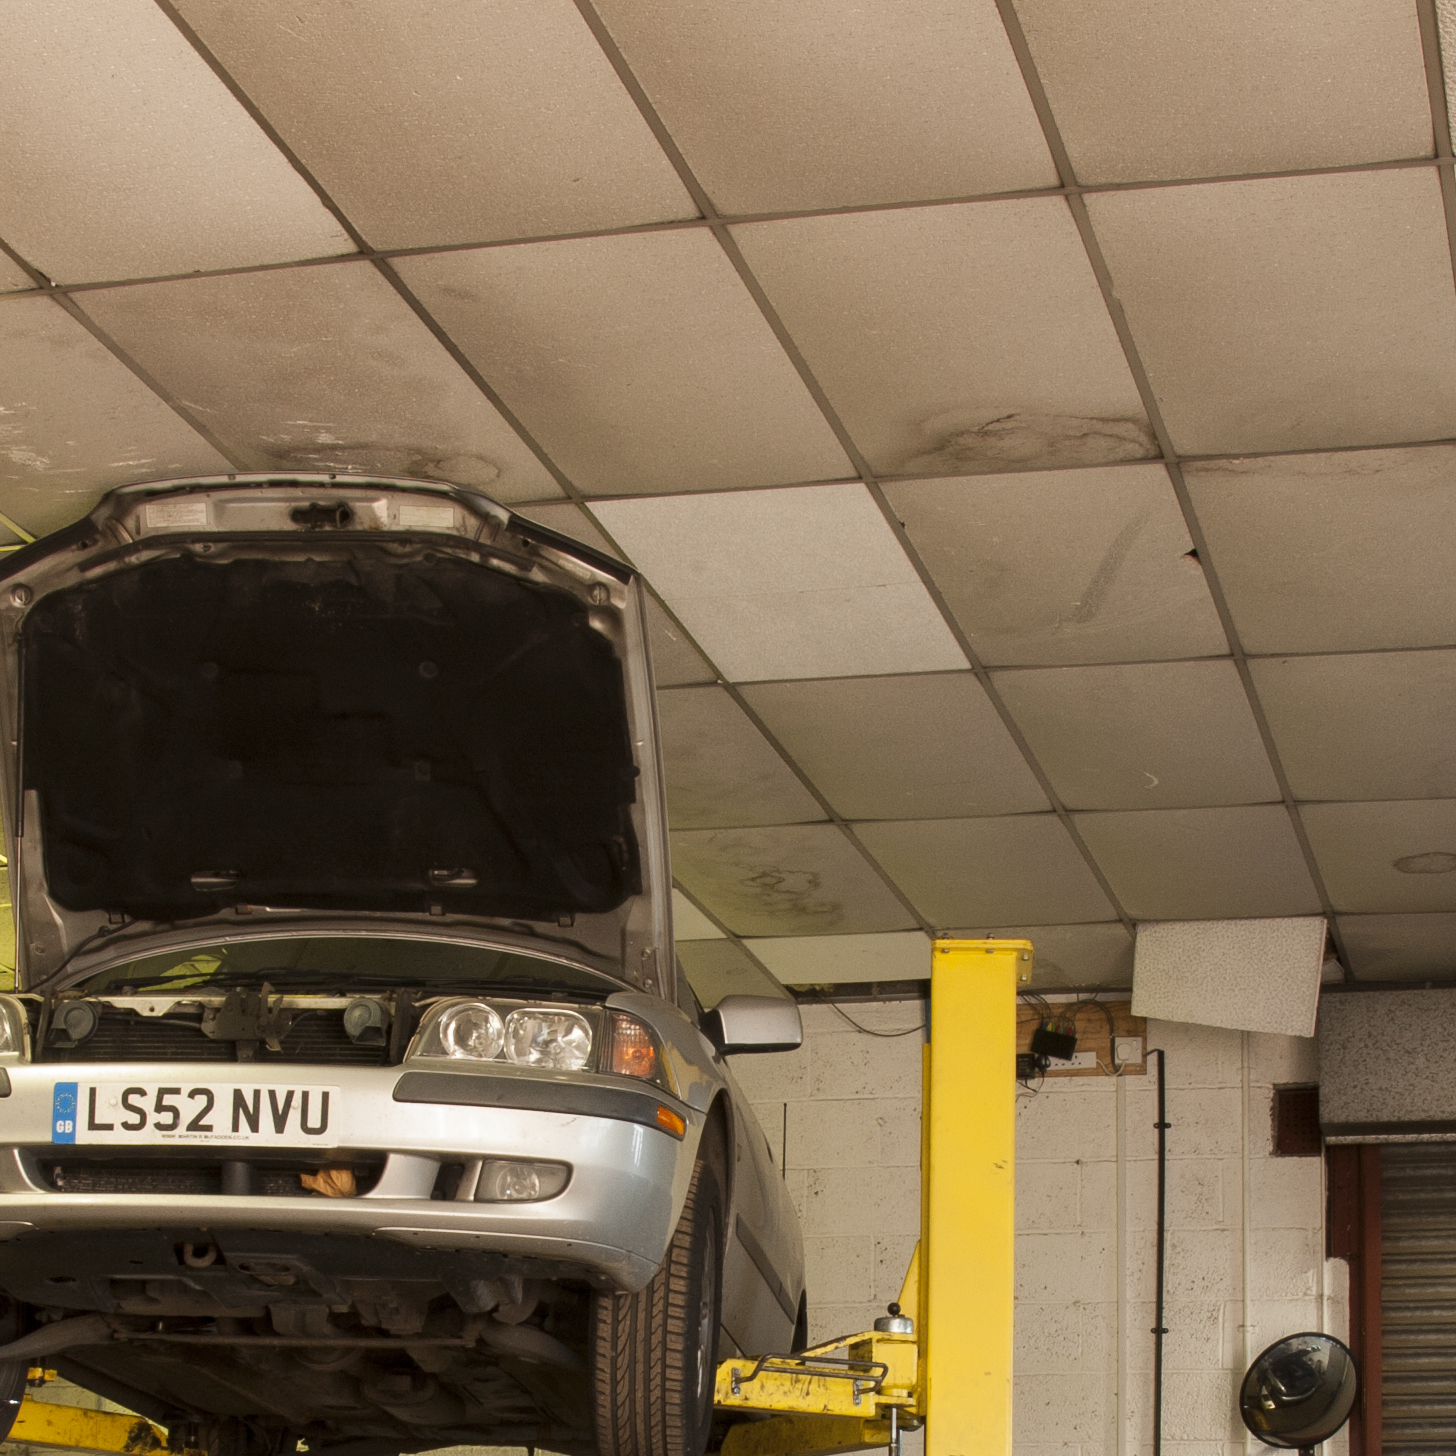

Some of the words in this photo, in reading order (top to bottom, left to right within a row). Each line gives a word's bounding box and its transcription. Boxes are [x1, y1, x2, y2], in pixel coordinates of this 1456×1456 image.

[55, 1120, 74, 1133] GB
[87, 1086, 215, 1131] LS52
[231, 1088, 330, 1136] NVU
